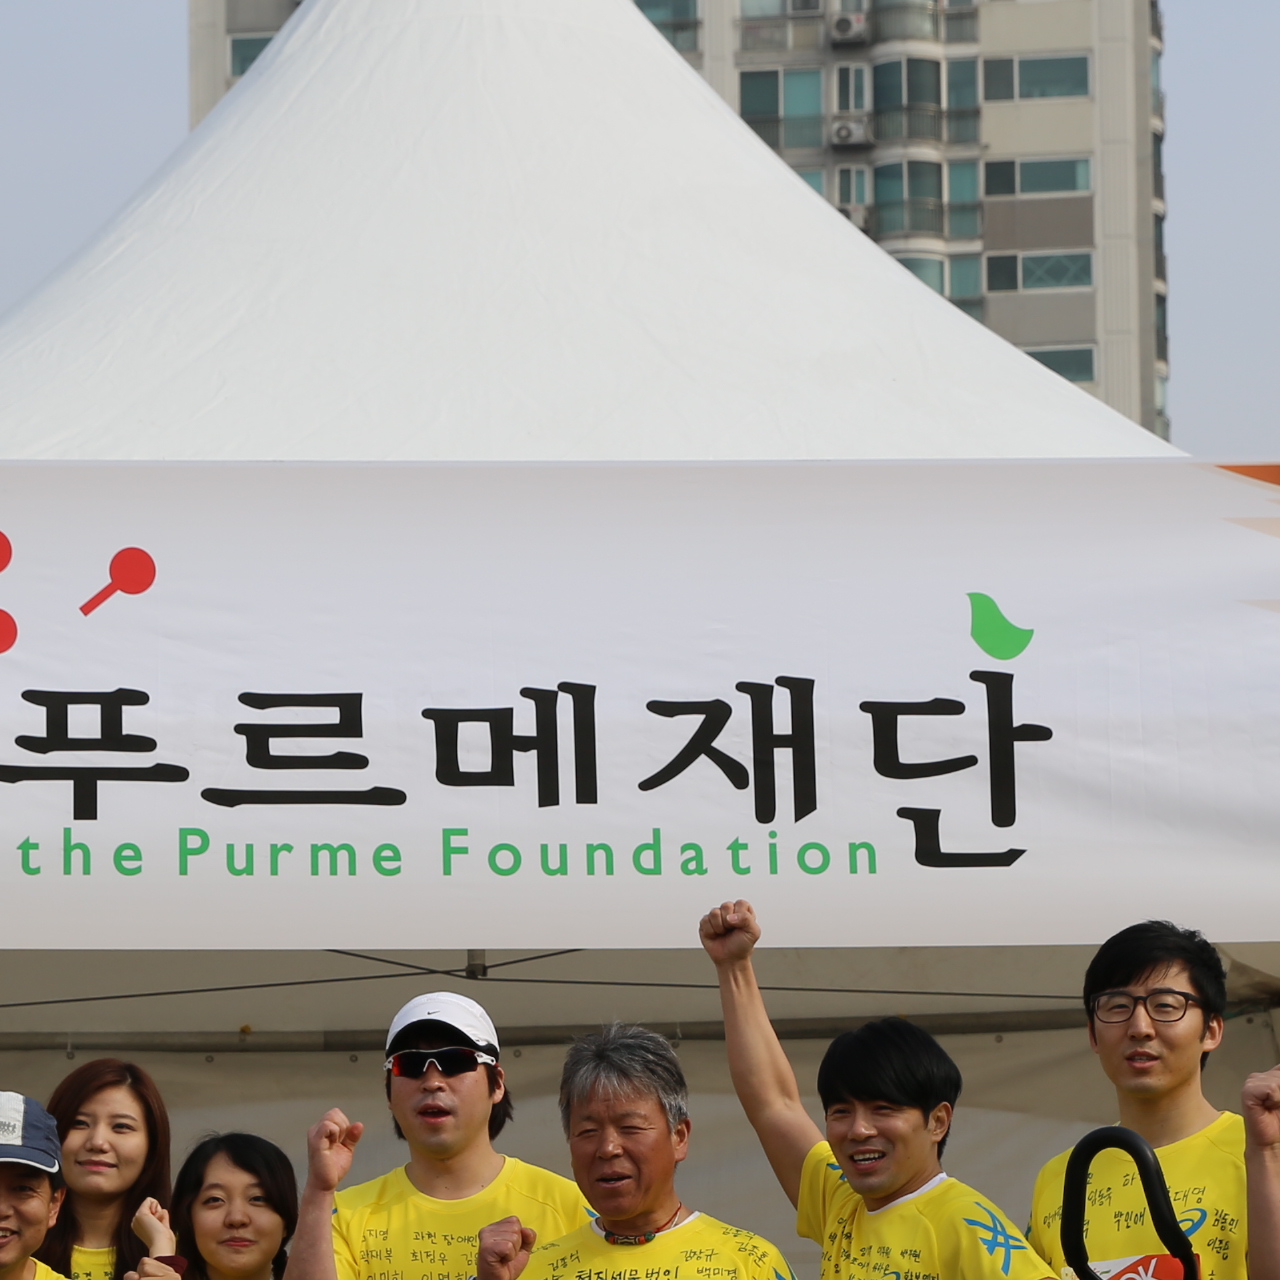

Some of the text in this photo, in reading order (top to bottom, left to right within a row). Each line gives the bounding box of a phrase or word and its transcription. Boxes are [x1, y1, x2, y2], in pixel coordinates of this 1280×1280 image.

[17, 827, 877, 876] the Purme Foundation
